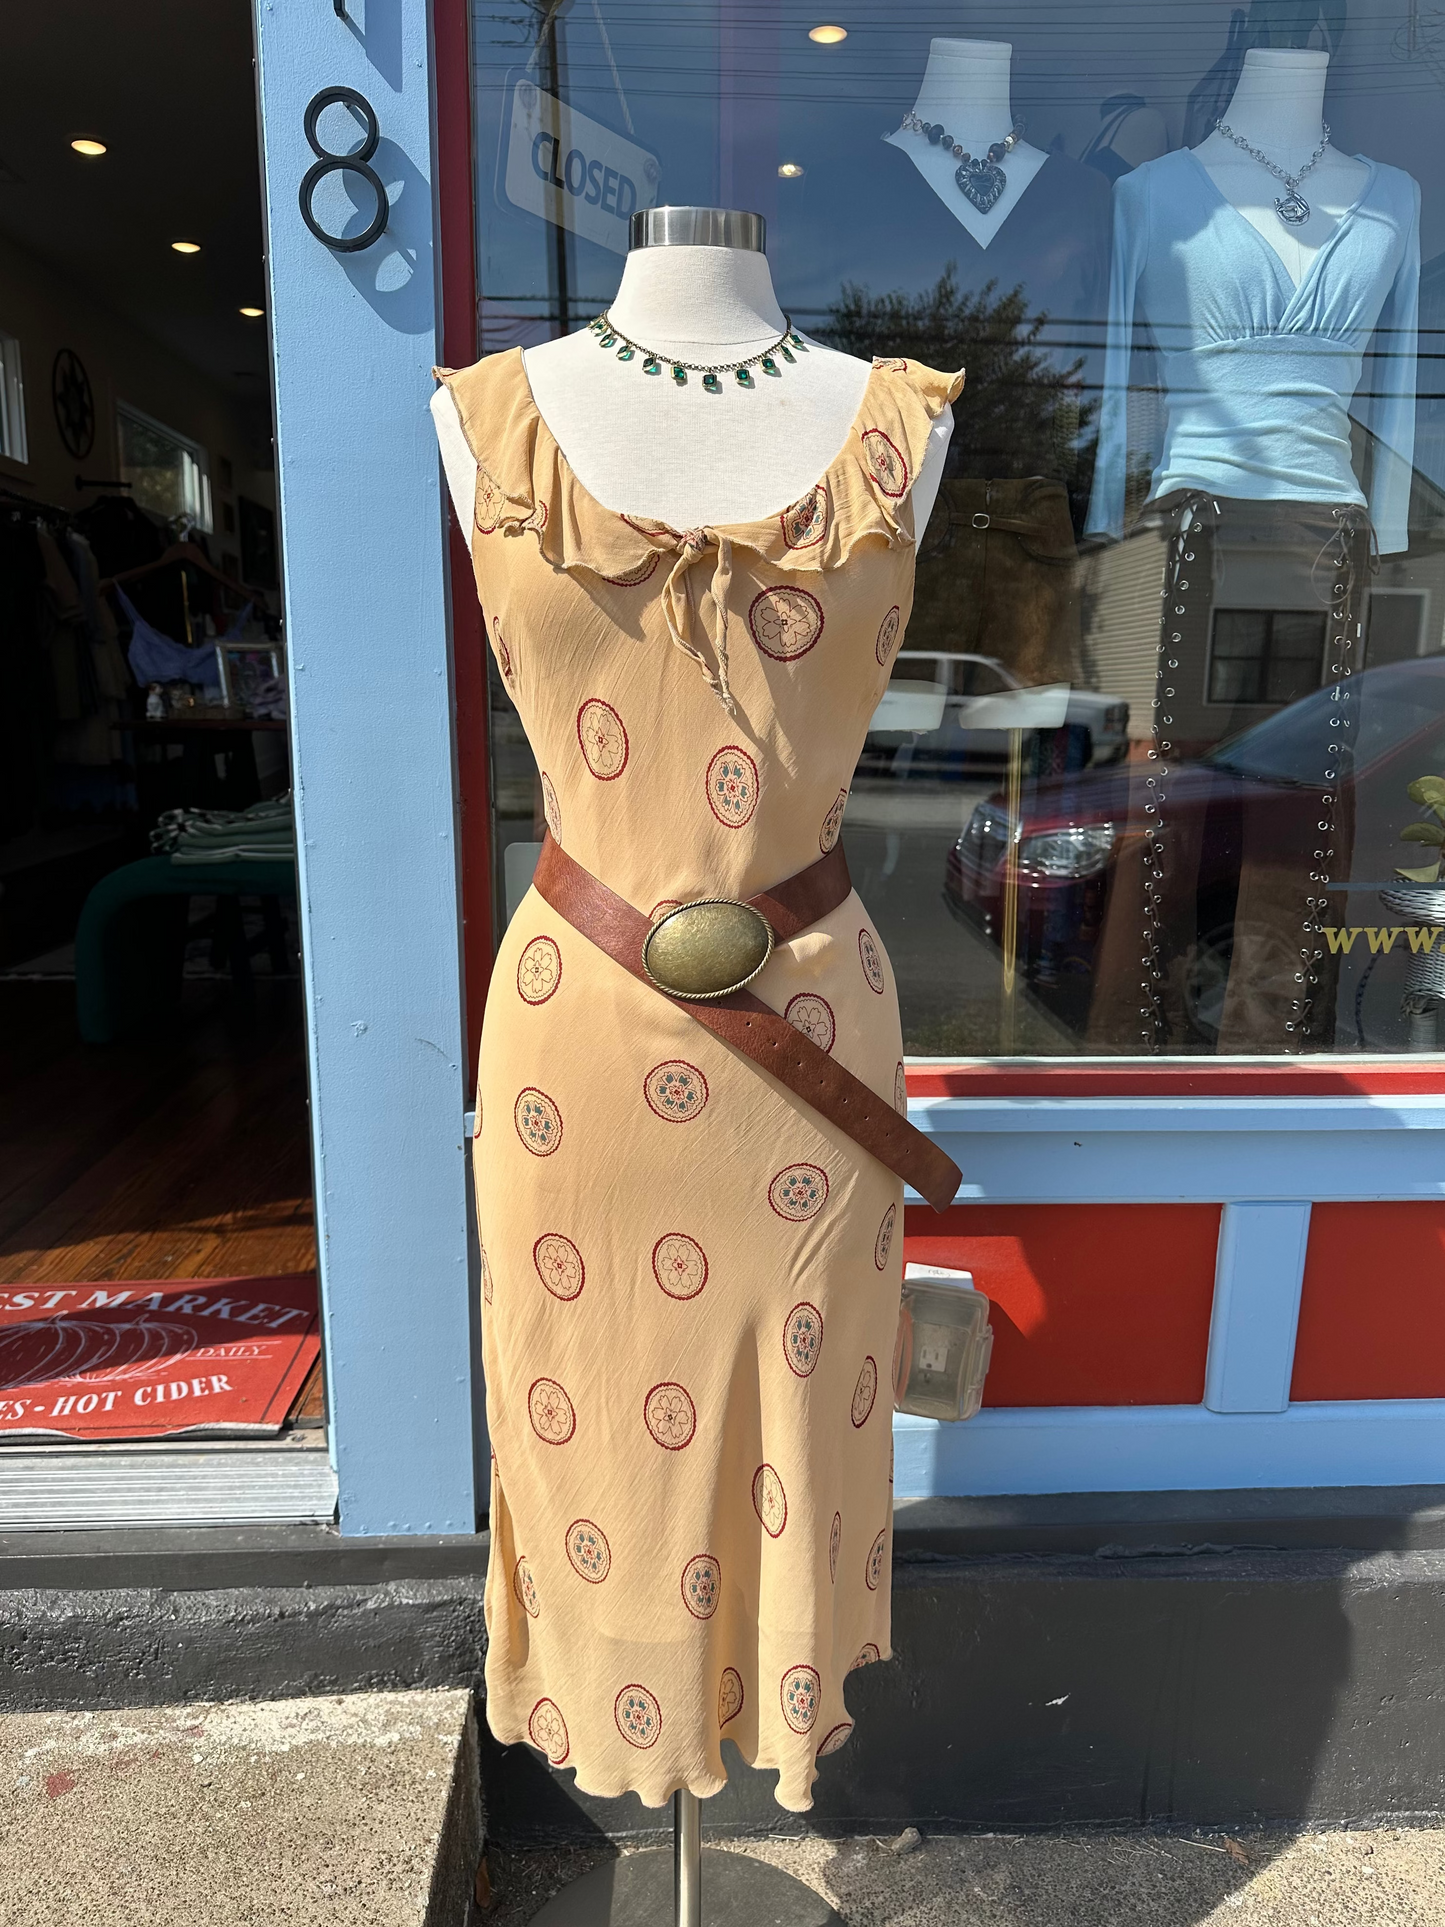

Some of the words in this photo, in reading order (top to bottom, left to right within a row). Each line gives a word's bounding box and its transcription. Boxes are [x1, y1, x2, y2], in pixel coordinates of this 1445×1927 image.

[298, 86, 389, 252] 8
[531, 131, 638, 221] CLOSED
[0, 1290, 78, 1311] ST
[76, 1290, 310, 1329] MARKET
[196, 1345, 267, 1357] DAILY
[48, 1390, 122, 1417] HOT
[134, 1374, 233, 1407] CIDER
